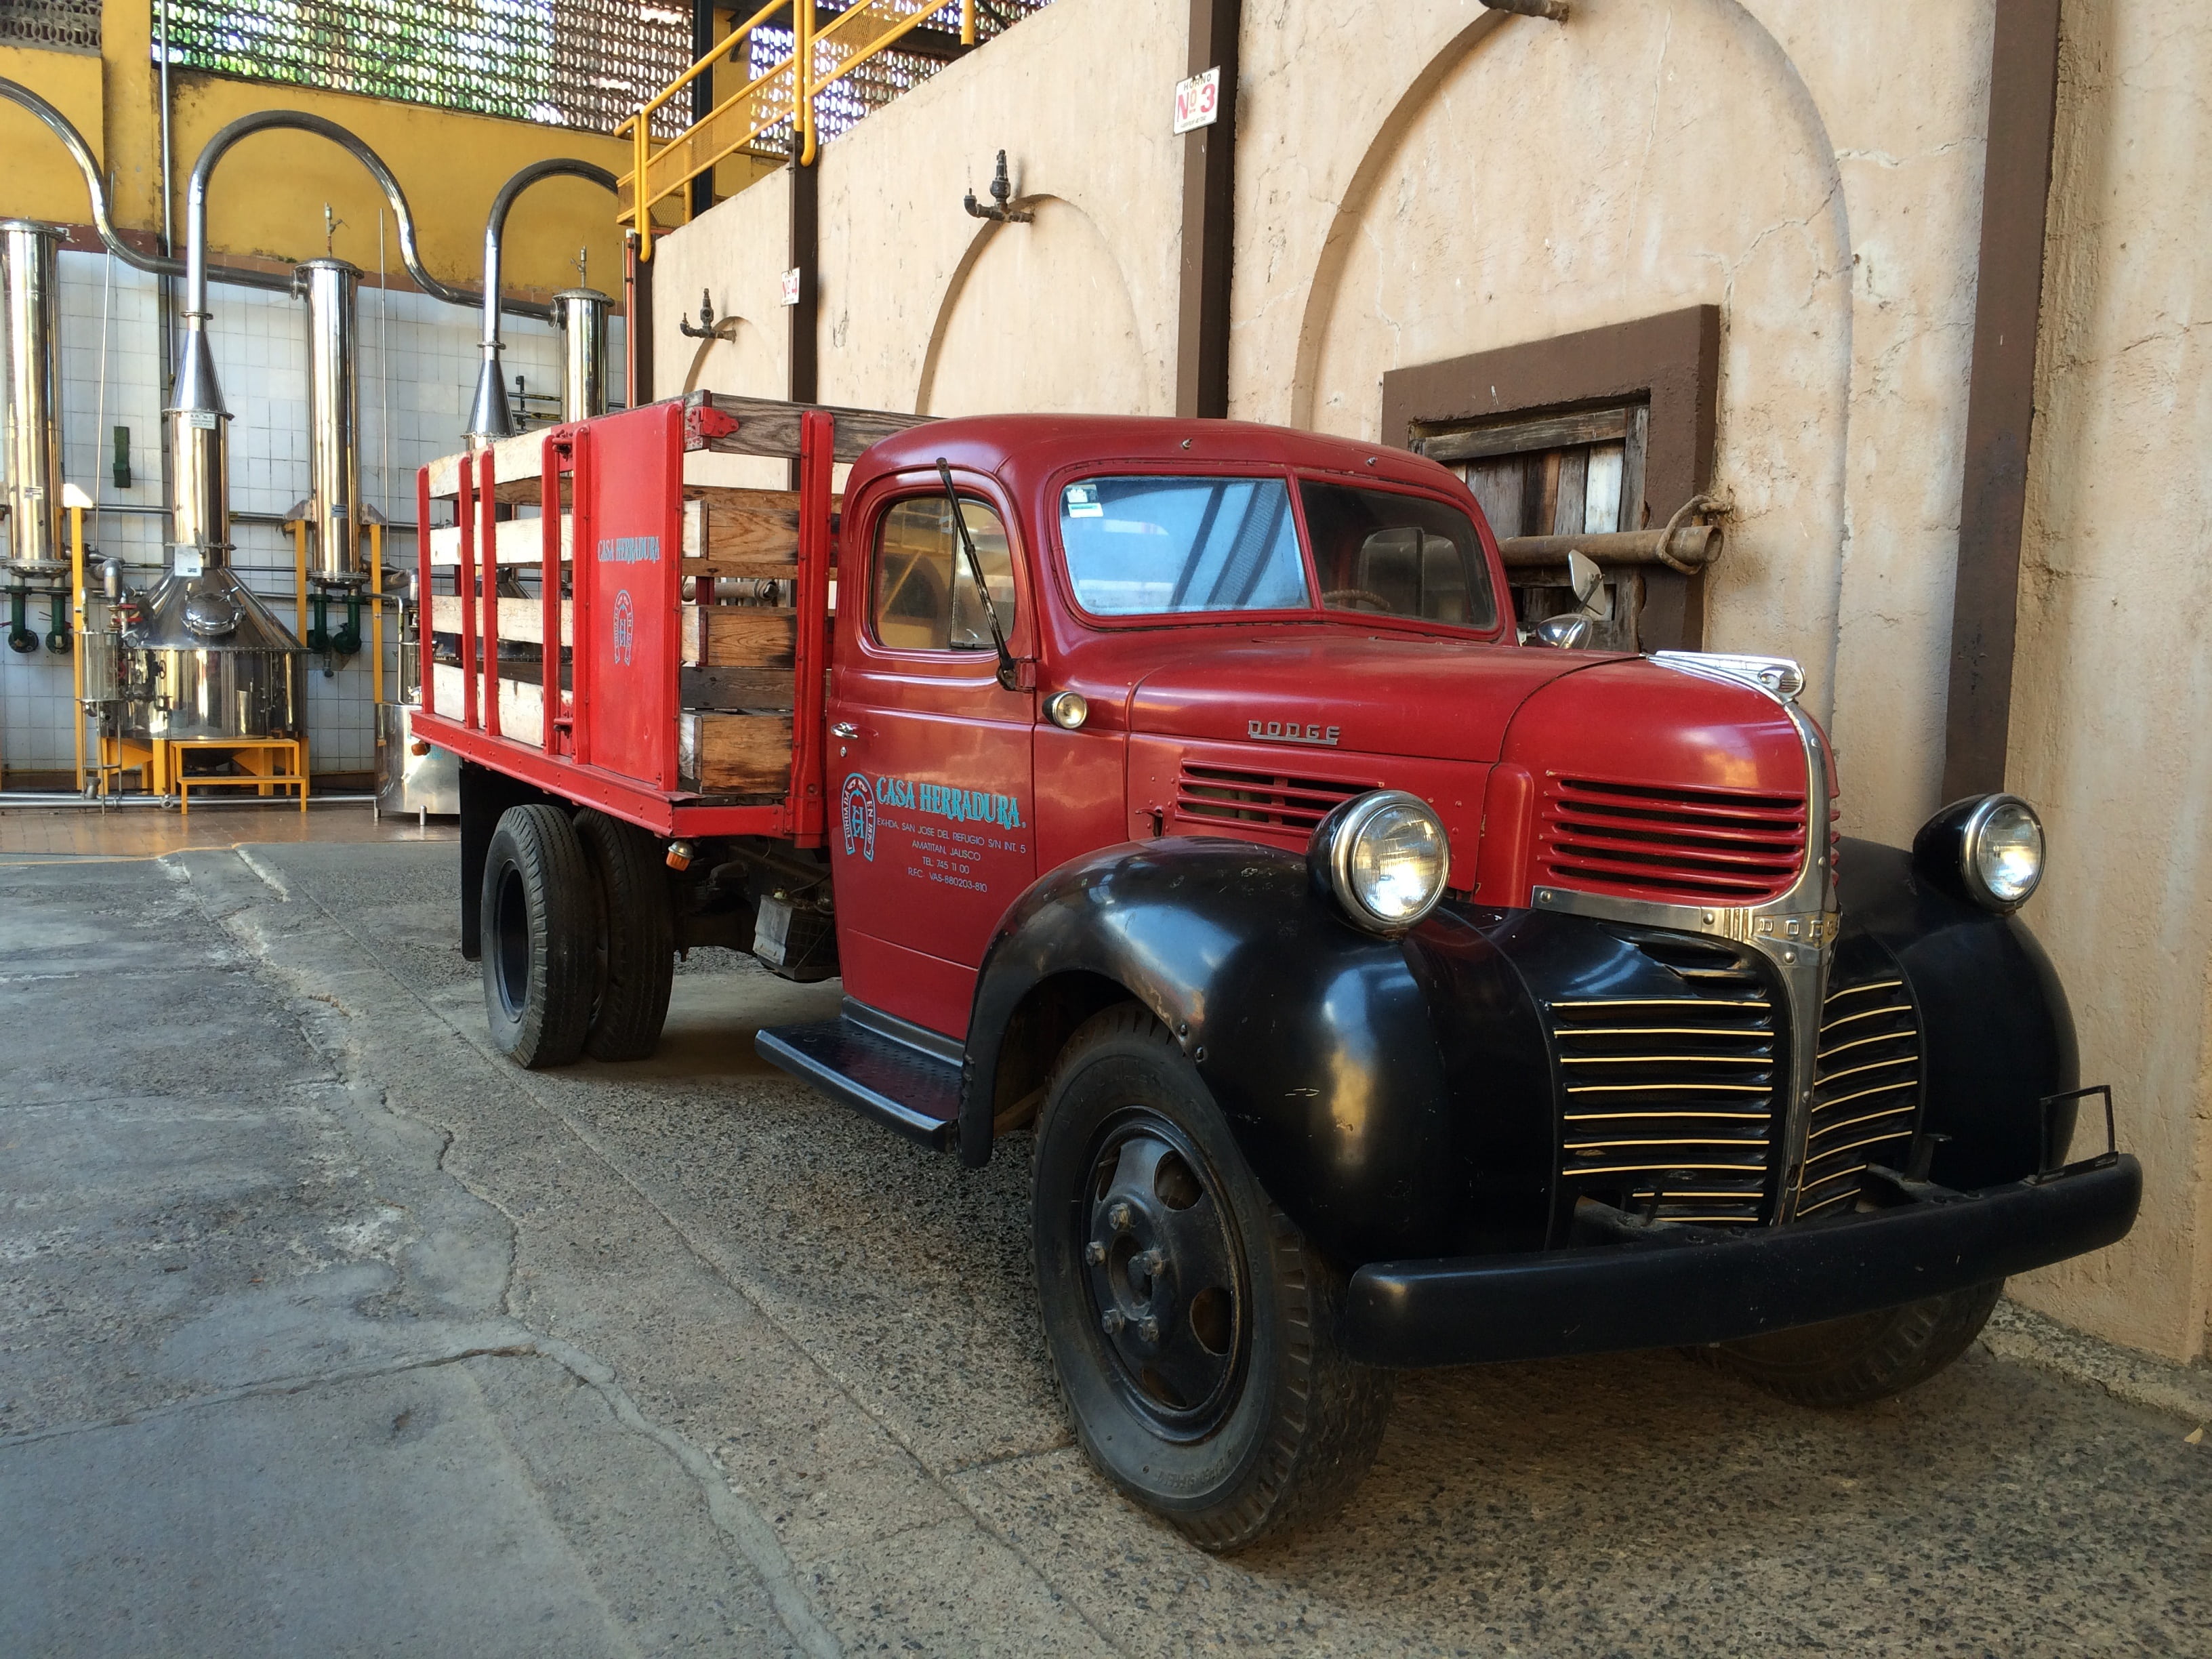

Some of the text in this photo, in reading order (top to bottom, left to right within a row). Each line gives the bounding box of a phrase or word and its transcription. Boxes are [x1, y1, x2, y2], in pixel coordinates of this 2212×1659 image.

[1200, 83, 1216, 113] 3
[792, 277, 798, 295] 4
[598, 536, 660, 564] CASA HERRADURA
[1248, 720, 1340, 745] DODGE
[876, 777, 1021, 830] CASA HERRADURA
[901, 822, 916, 833] SAN
[918, 826, 935, 837] JOSE
[937, 829, 949, 840] DEL
[952, 832, 985, 846] REFUGIO
[987, 838, 1001, 849] S/N
[1020, 844, 1026, 854] 5
[937, 859, 949, 870] 745
[951, 862, 956, 872] 11
[949, 847, 981, 861] JALISCO
[1760, 918, 1838, 937] DODG
